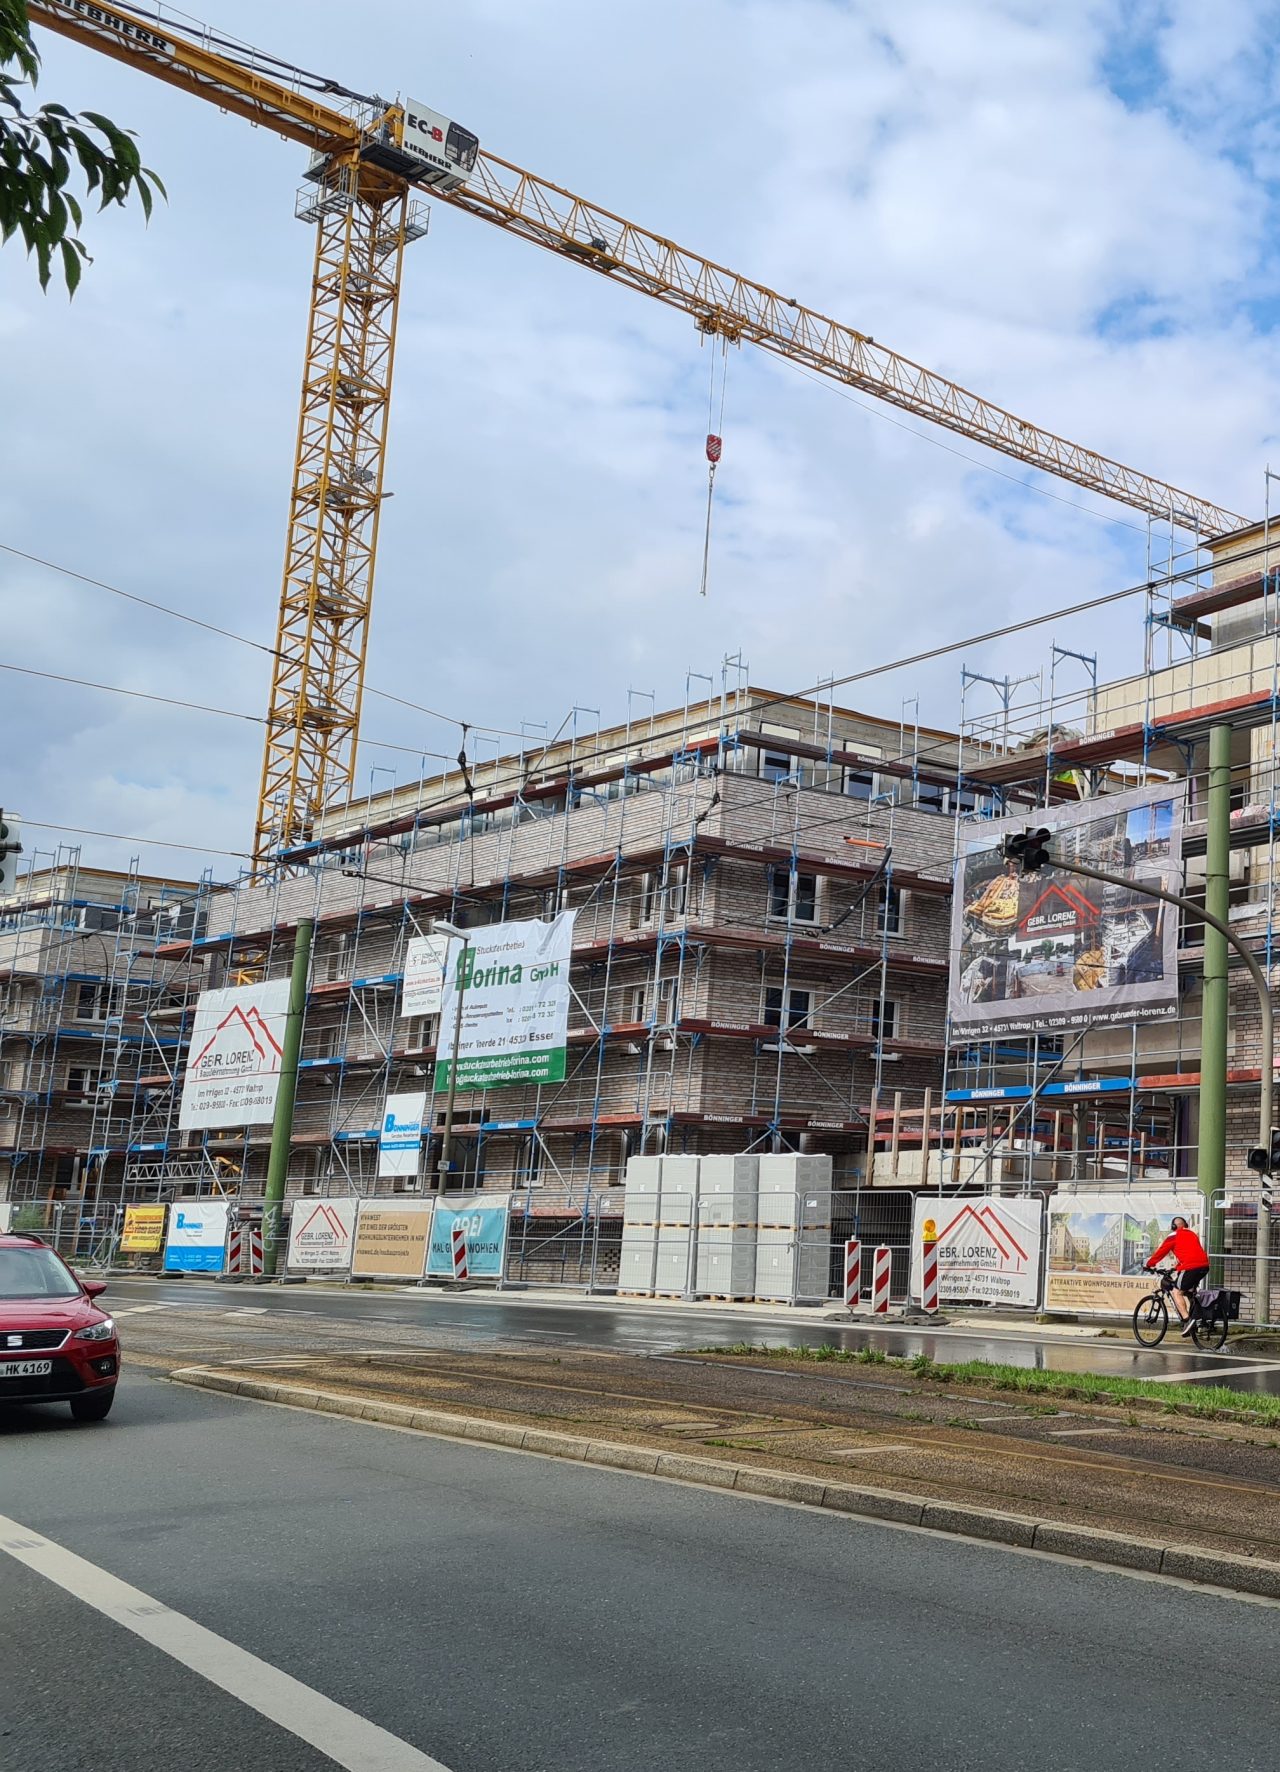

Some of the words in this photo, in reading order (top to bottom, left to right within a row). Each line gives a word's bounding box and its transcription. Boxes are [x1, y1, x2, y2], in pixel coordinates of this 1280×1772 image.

[408, 113, 443, 143] EC-B
[824, 857, 861, 868] BÖNNINGER
[1027, 917, 1046, 927] GEBR.
[1047, 911, 1077, 923] LORENZ
[819, 943, 855, 954] BÖNNINGER
[912, 955, 946, 965] BÖNNINGER
[711, 1021, 750, 1031] BÖNNINGER
[812, 1030, 849, 1040] BÖNNINGER
[1064, 1082, 1101, 1093] BÖNNINGER
[971, 1088, 1005, 1099] BÖNNINGER
[703, 1113, 744, 1124] BÖNNINGER
[807, 1120, 844, 1129] BÖNNINGER
[432, 1242, 444, 1254] MAL
[939, 1247, 960, 1258] EBR.
[962, 1246, 998, 1259] LORENZ
[1050, 1278, 1082, 1287] ATTRAKTIVE
[1083, 1279, 1122, 1289] WOHNFORMEN
[1123, 1280, 1134, 1289] FÜR
[1135, 1281, 1149, 1290] ALLE
[6, 1364, 20, 1375] HK
[23, 1362, 50, 1374] 4169
